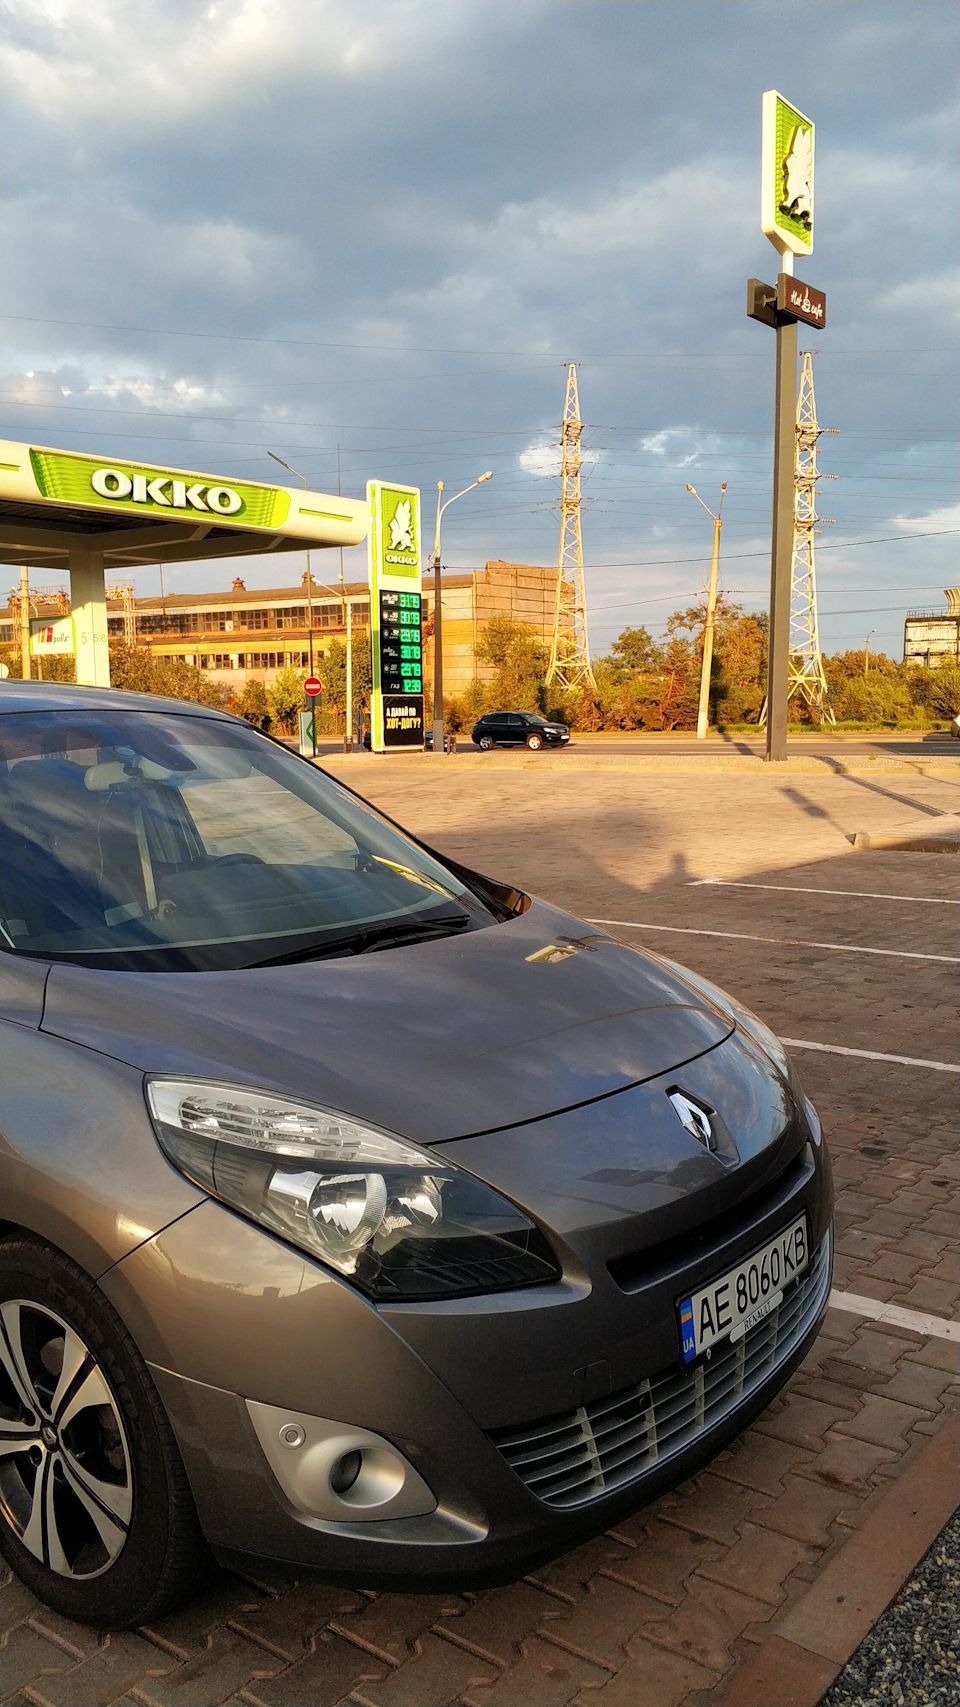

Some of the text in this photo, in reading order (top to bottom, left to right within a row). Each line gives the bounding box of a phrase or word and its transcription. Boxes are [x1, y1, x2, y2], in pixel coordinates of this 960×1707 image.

[90, 468, 243, 515] OKKO
[385, 554, 418, 566] OKKO
[81, 632, 88, 645] 5
[386, 705, 417, 718] А ДАВАЙ ПО
[386, 717, 422, 730] ХОТ-ДОГУ?
[699, 1226, 806, 1345] AE 8060 KB
[743, 1301, 772, 1331] RENAULT
[683, 1336, 695, 1354] UA
